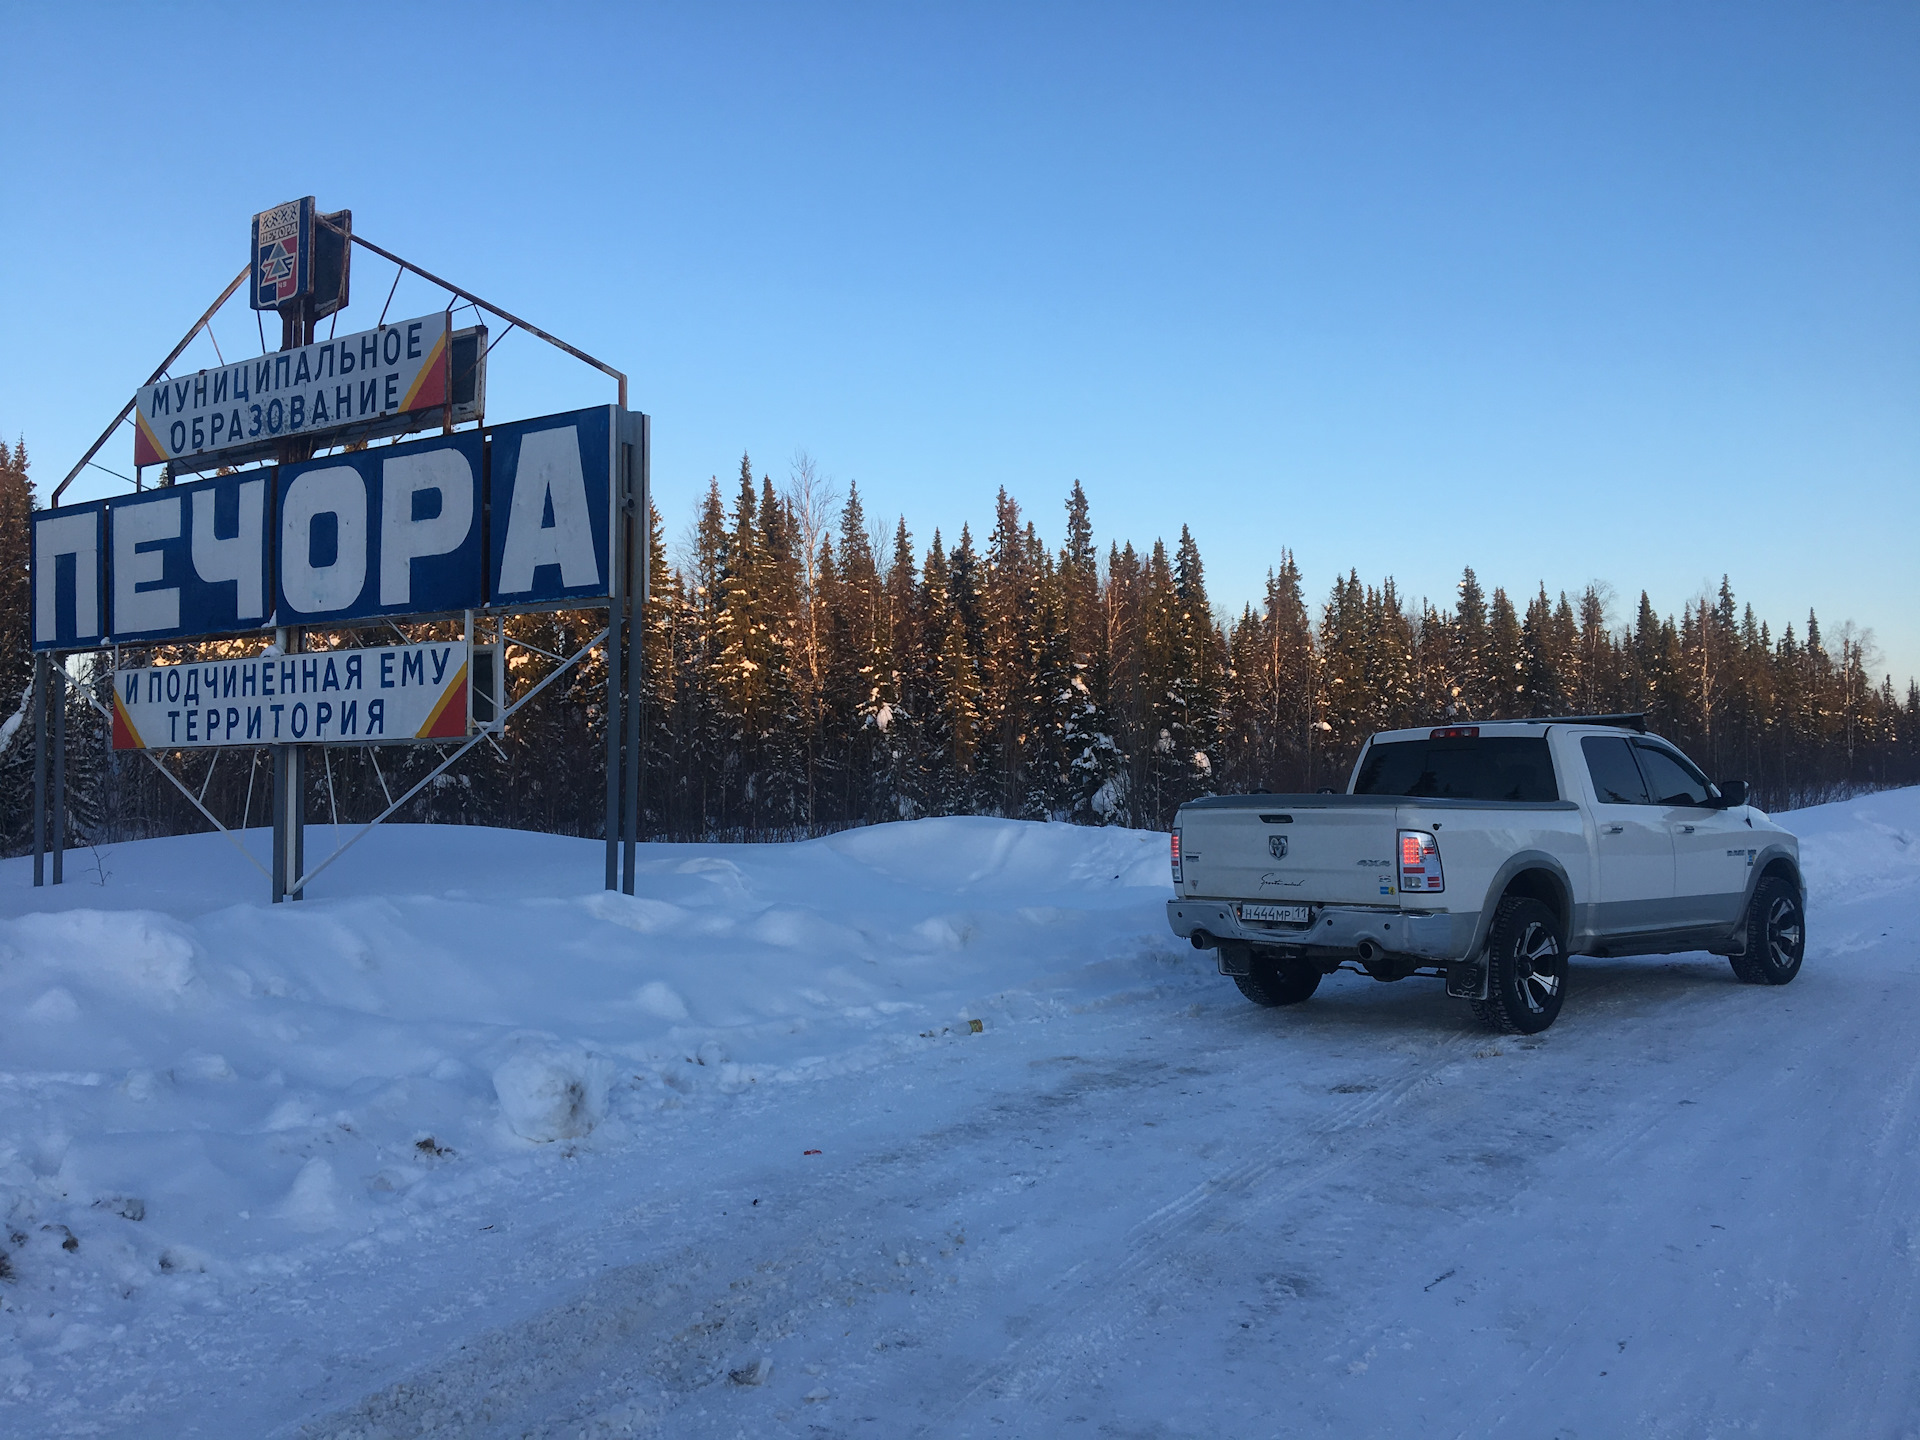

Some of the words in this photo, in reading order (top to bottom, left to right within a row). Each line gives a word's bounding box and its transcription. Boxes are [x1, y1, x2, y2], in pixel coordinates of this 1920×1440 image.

[261, 223, 297, 243] ПЕЧОРА
[151, 322, 423, 419] МУНИЦИПАЛЬНОЕ
[170, 372, 399, 454] ОБРАЗОВАНИЕ
[35, 425, 600, 642] ПЕЧОРА
[125, 673, 139, 704] И
[149, 655, 362, 706] ПОДЧИНЕННАЯ
[380, 647, 451, 689] ЕМУ
[168, 698, 385, 743] ТЕРРИТОРИЯ
[1294, 907, 1306, 918] 11
